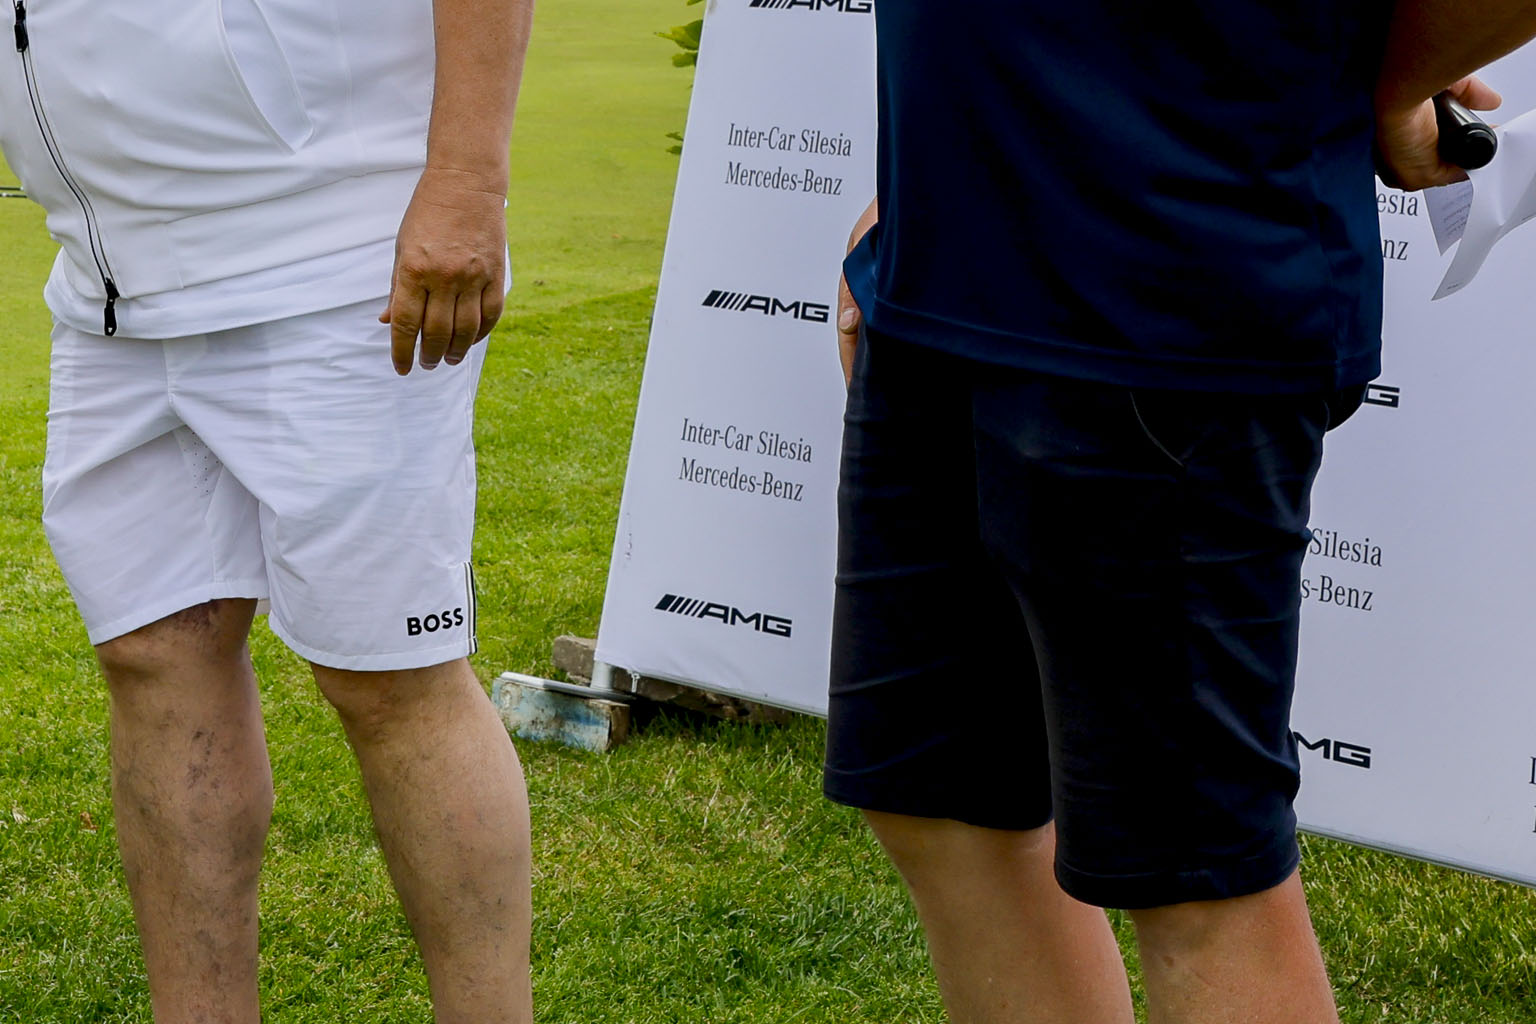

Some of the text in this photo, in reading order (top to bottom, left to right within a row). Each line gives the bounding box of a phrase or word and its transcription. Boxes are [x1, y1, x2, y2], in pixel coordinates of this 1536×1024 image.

[727, 123, 852, 158] Inter-Car Silesia
[725, 161, 843, 196] Mercedes-Benz
[1376, 190, 1418, 217] esia
[740, 295, 830, 323] AMG
[680, 418, 813, 463] Inter-Car Silesia
[678, 456, 804, 503] Mercedes-Benz
[1309, 527, 1382, 567] Silesia
[406, 608, 464, 636] BOSS
[698, 602, 792, 638] AMG
[1292, 731, 1371, 769] MG
